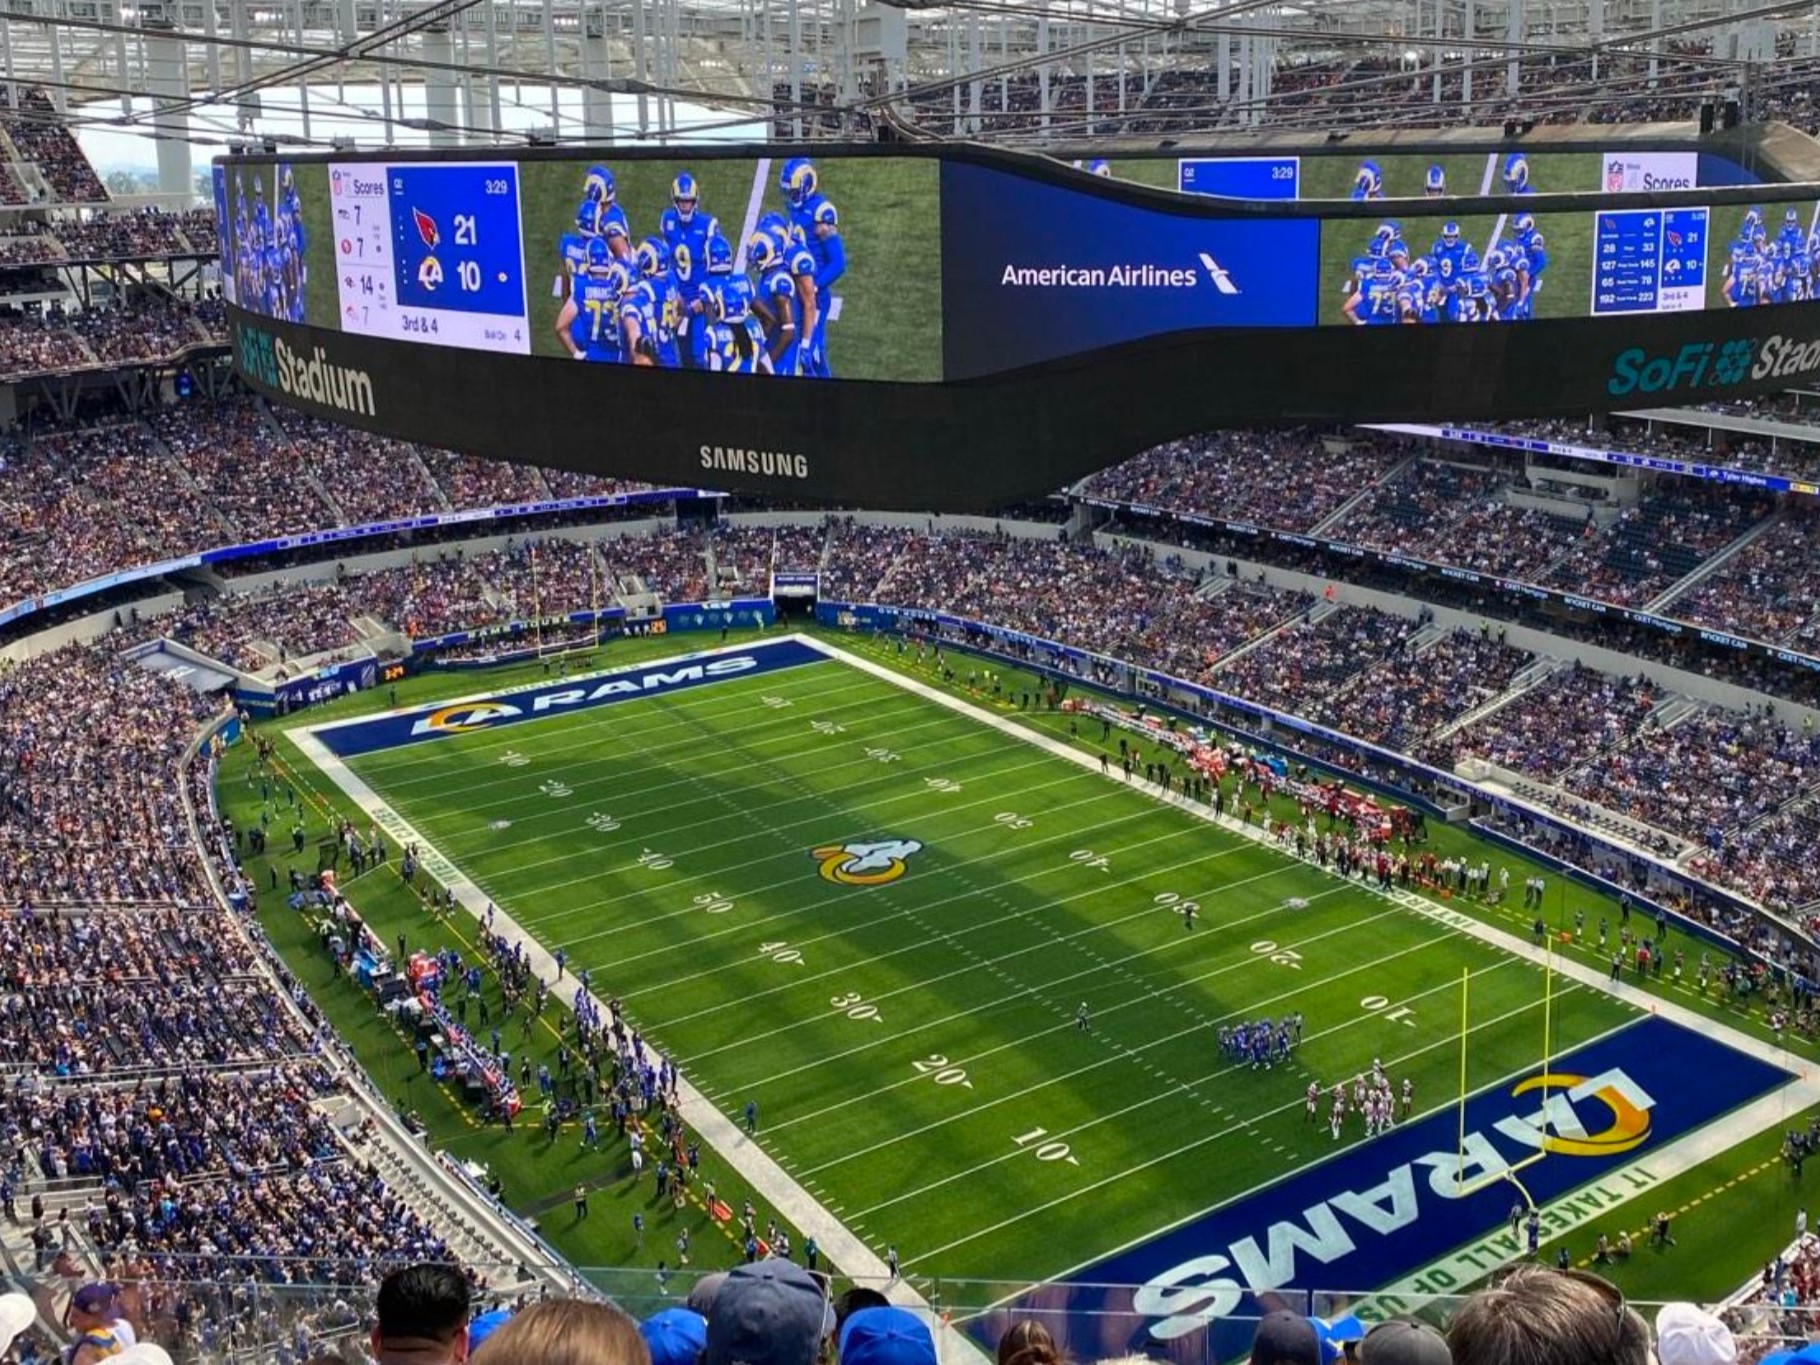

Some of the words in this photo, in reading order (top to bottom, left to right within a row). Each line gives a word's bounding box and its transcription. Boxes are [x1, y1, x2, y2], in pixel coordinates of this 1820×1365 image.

[1272, 167, 1294, 179] 3:29
[1643, 172, 1691, 191] Scores
[353, 179, 385, 196] Scores
[486, 180, 508, 194] 3:29
[353, 205, 362, 226] 7
[454, 214, 477, 245] 21
[1687, 232, 1698, 243] 21
[356, 237, 364, 258] 7
[675, 244, 691, 282] 9
[1002, 264, 1105, 286] American
[1107, 264, 1197, 287] Airlines
[1440, 257, 1452, 278] 9
[1686, 260, 1697, 270] 10
[360, 274, 373, 296] 14
[457, 260, 481, 292] 10
[402, 315, 419, 332] 3rd
[421, 317, 428, 333] &
[431, 318, 438, 334] 4
[514, 328, 521, 342] 4
[274, 336, 376, 416] Stadium
[1608, 342, 1715, 396] SoFi
[700, 444, 809, 479] SAMSUNG
[533, 655, 758, 712] RAMS
[694, 891, 734, 913] 50
[758, 941, 801, 963] 40
[1250, 939, 1303, 966] 20
[830, 992, 878, 1020] 30
[1360, 995, 1416, 1023] 10
[911, 1054, 968, 1085] 20
[1493, 1066, 1657, 1156] LA
[1010, 1126, 1071, 1162] 10
[1624, 1166, 1658, 1190] IT
[1133, 1131, 1511, 1339] RAMS
[1457, 1233, 1524, 1270] ALL
[1412, 1268, 1458, 1298] OF
